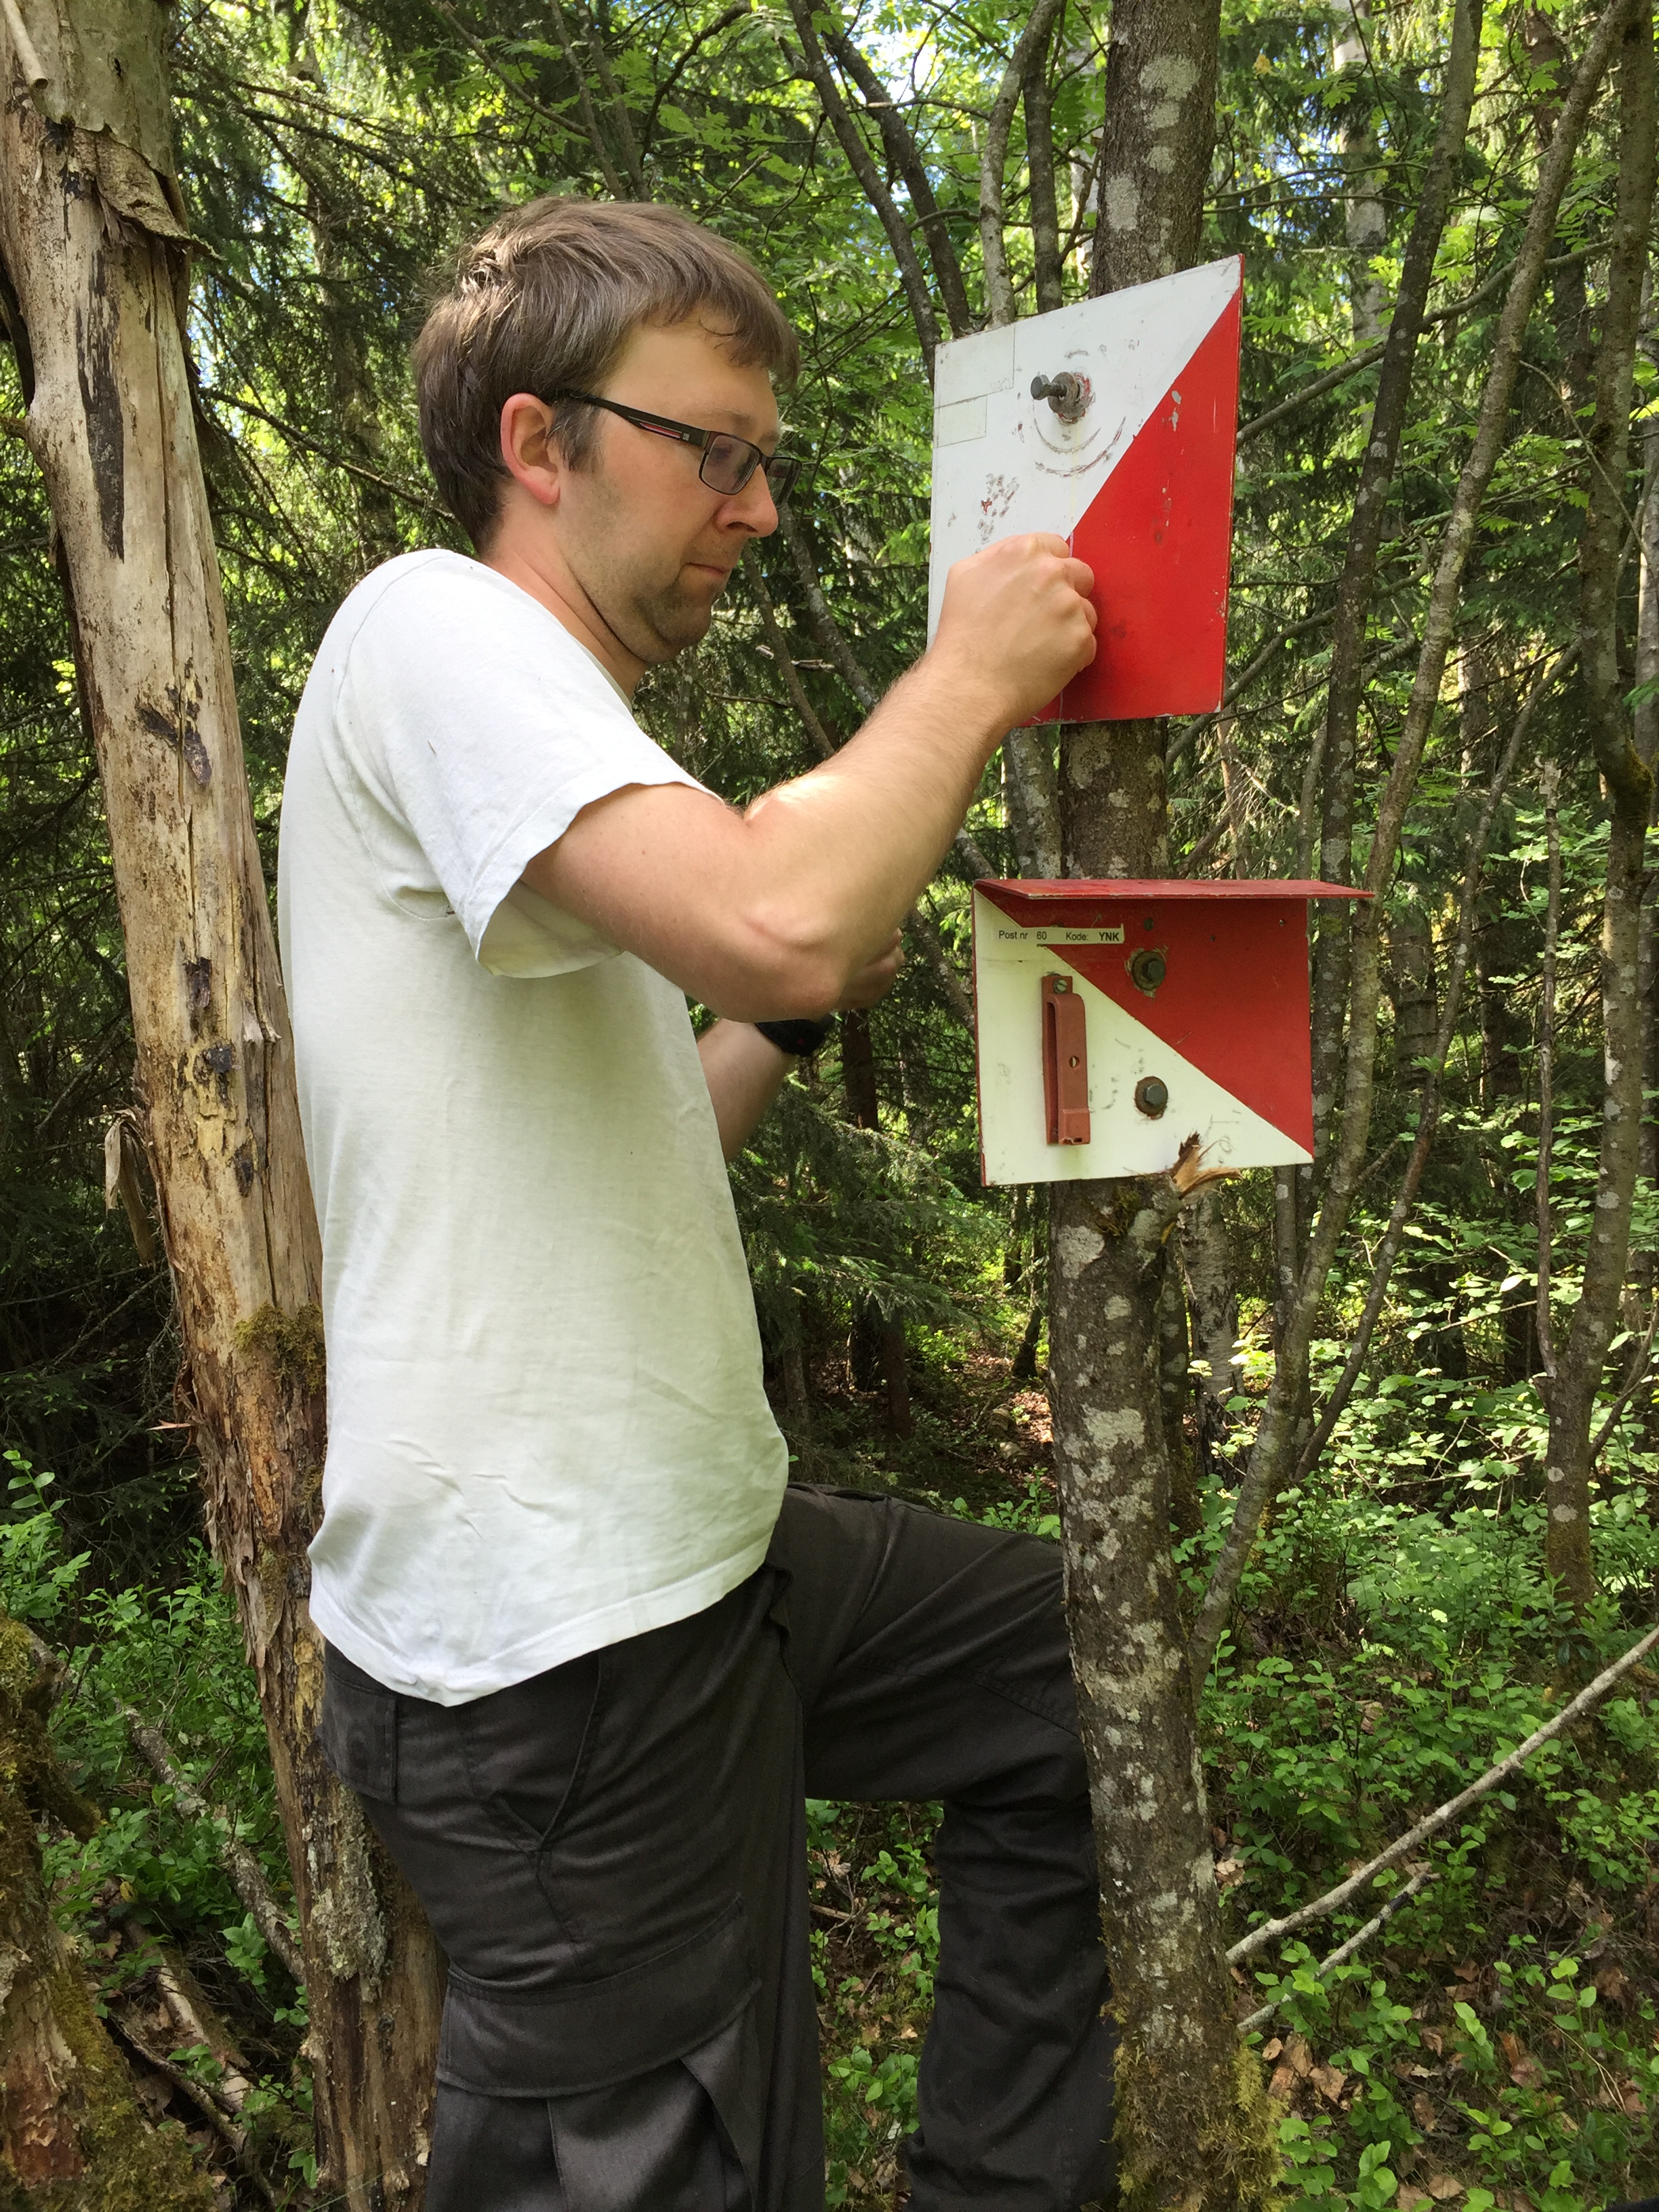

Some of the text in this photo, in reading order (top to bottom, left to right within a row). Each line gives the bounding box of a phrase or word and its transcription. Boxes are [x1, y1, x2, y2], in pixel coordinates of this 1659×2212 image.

[998, 930, 1017, 939] Post
[1036, 931, 1047, 940] 60
[1065, 932, 1089, 941] Kode:
[1099, 932, 1120, 941] YNK
